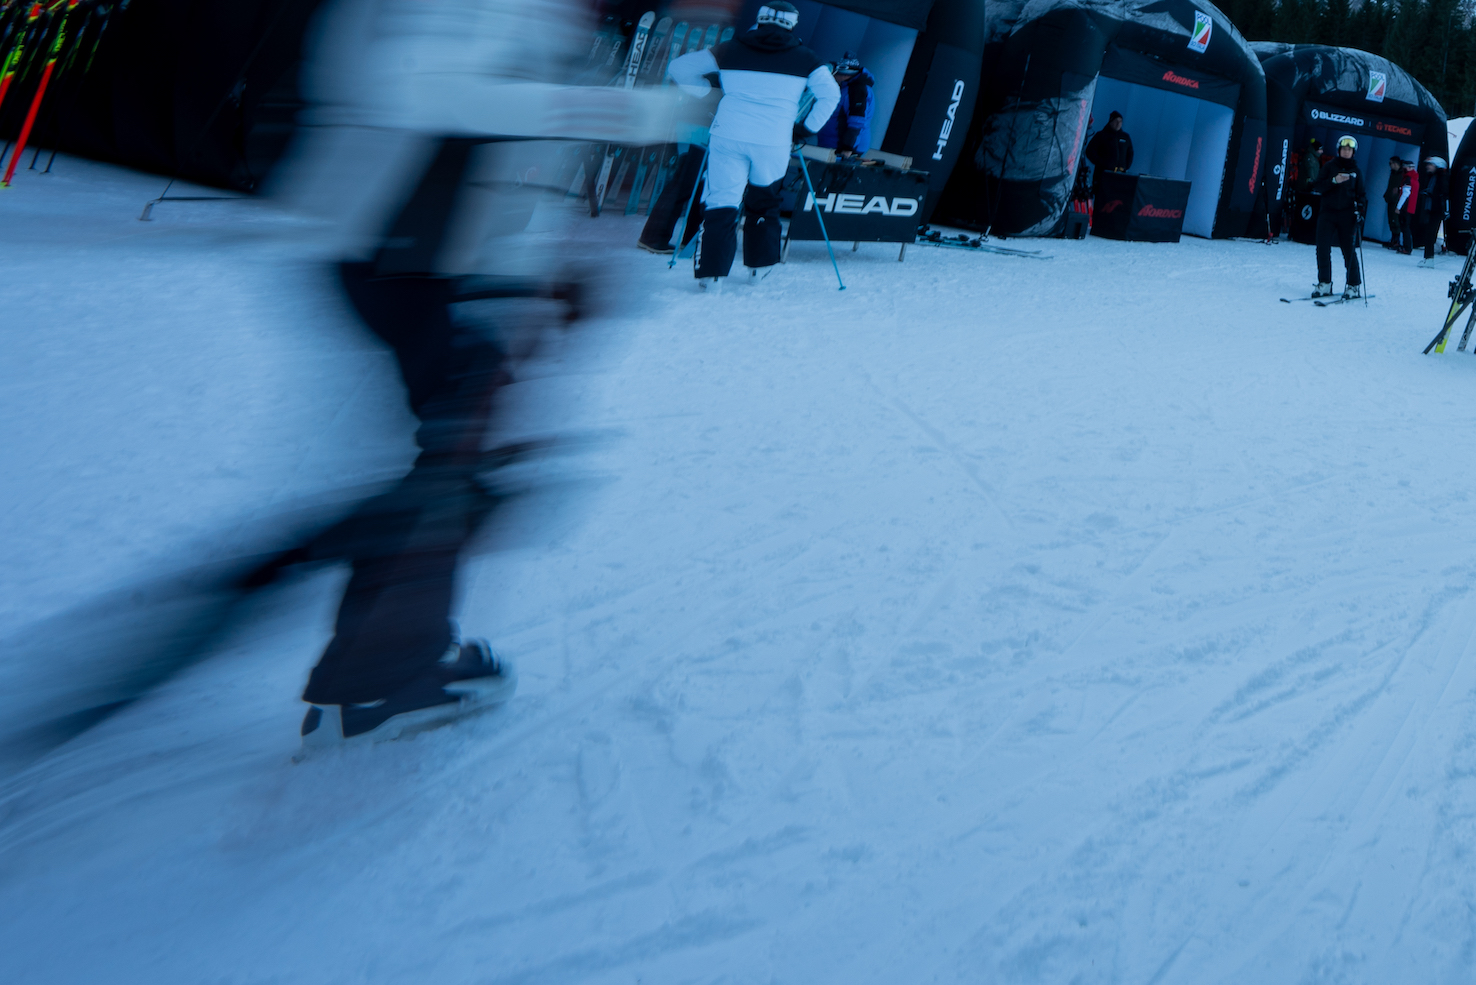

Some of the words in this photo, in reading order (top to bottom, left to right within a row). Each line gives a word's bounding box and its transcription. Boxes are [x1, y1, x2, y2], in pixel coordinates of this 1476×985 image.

[1161, 70, 1199, 90] NORDICA
[931, 79, 965, 161] HEAD
[1319, 110, 1365, 127] BLIZZARD
[1275, 138, 1289, 201] BLIZZARD
[802, 191, 919, 217] HEAD
[1462, 175, 1476, 221] DYNASTAR
